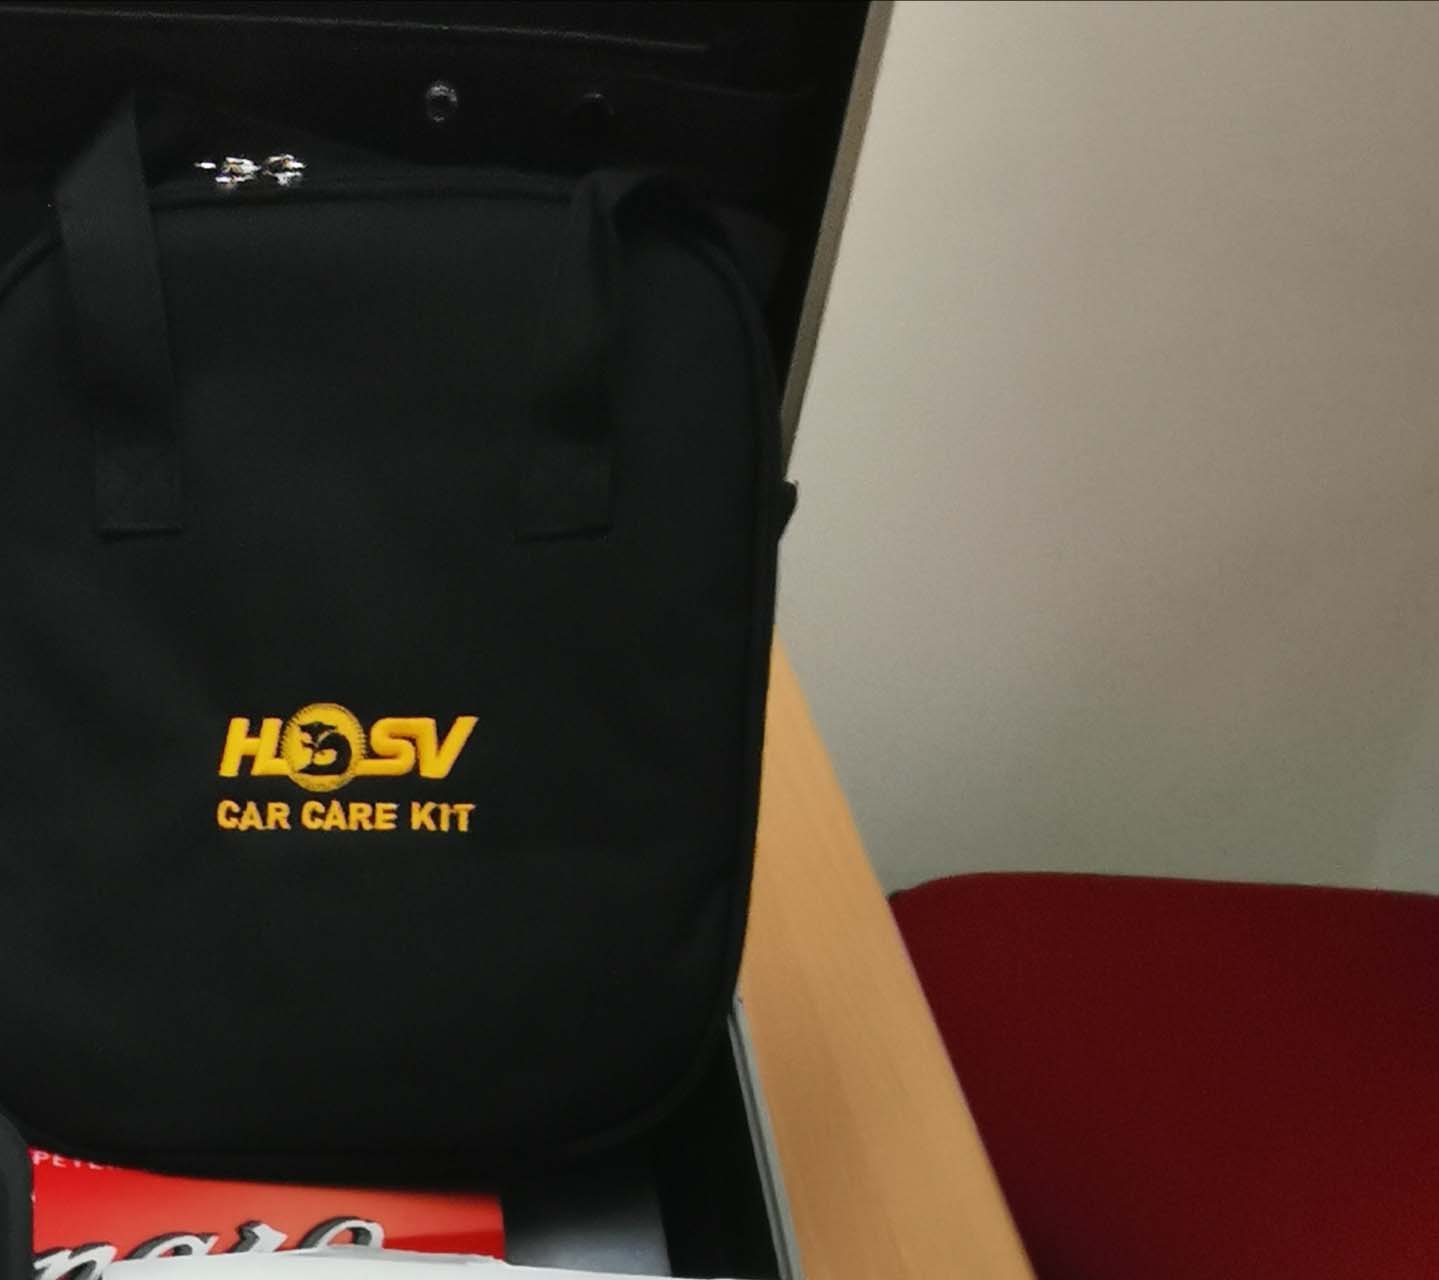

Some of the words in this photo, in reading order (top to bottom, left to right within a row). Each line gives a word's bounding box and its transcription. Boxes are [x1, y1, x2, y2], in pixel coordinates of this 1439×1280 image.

[217, 800, 290, 832] CAR
[301, 800, 397, 832] CARE
[411, 803, 475, 832] KIT
